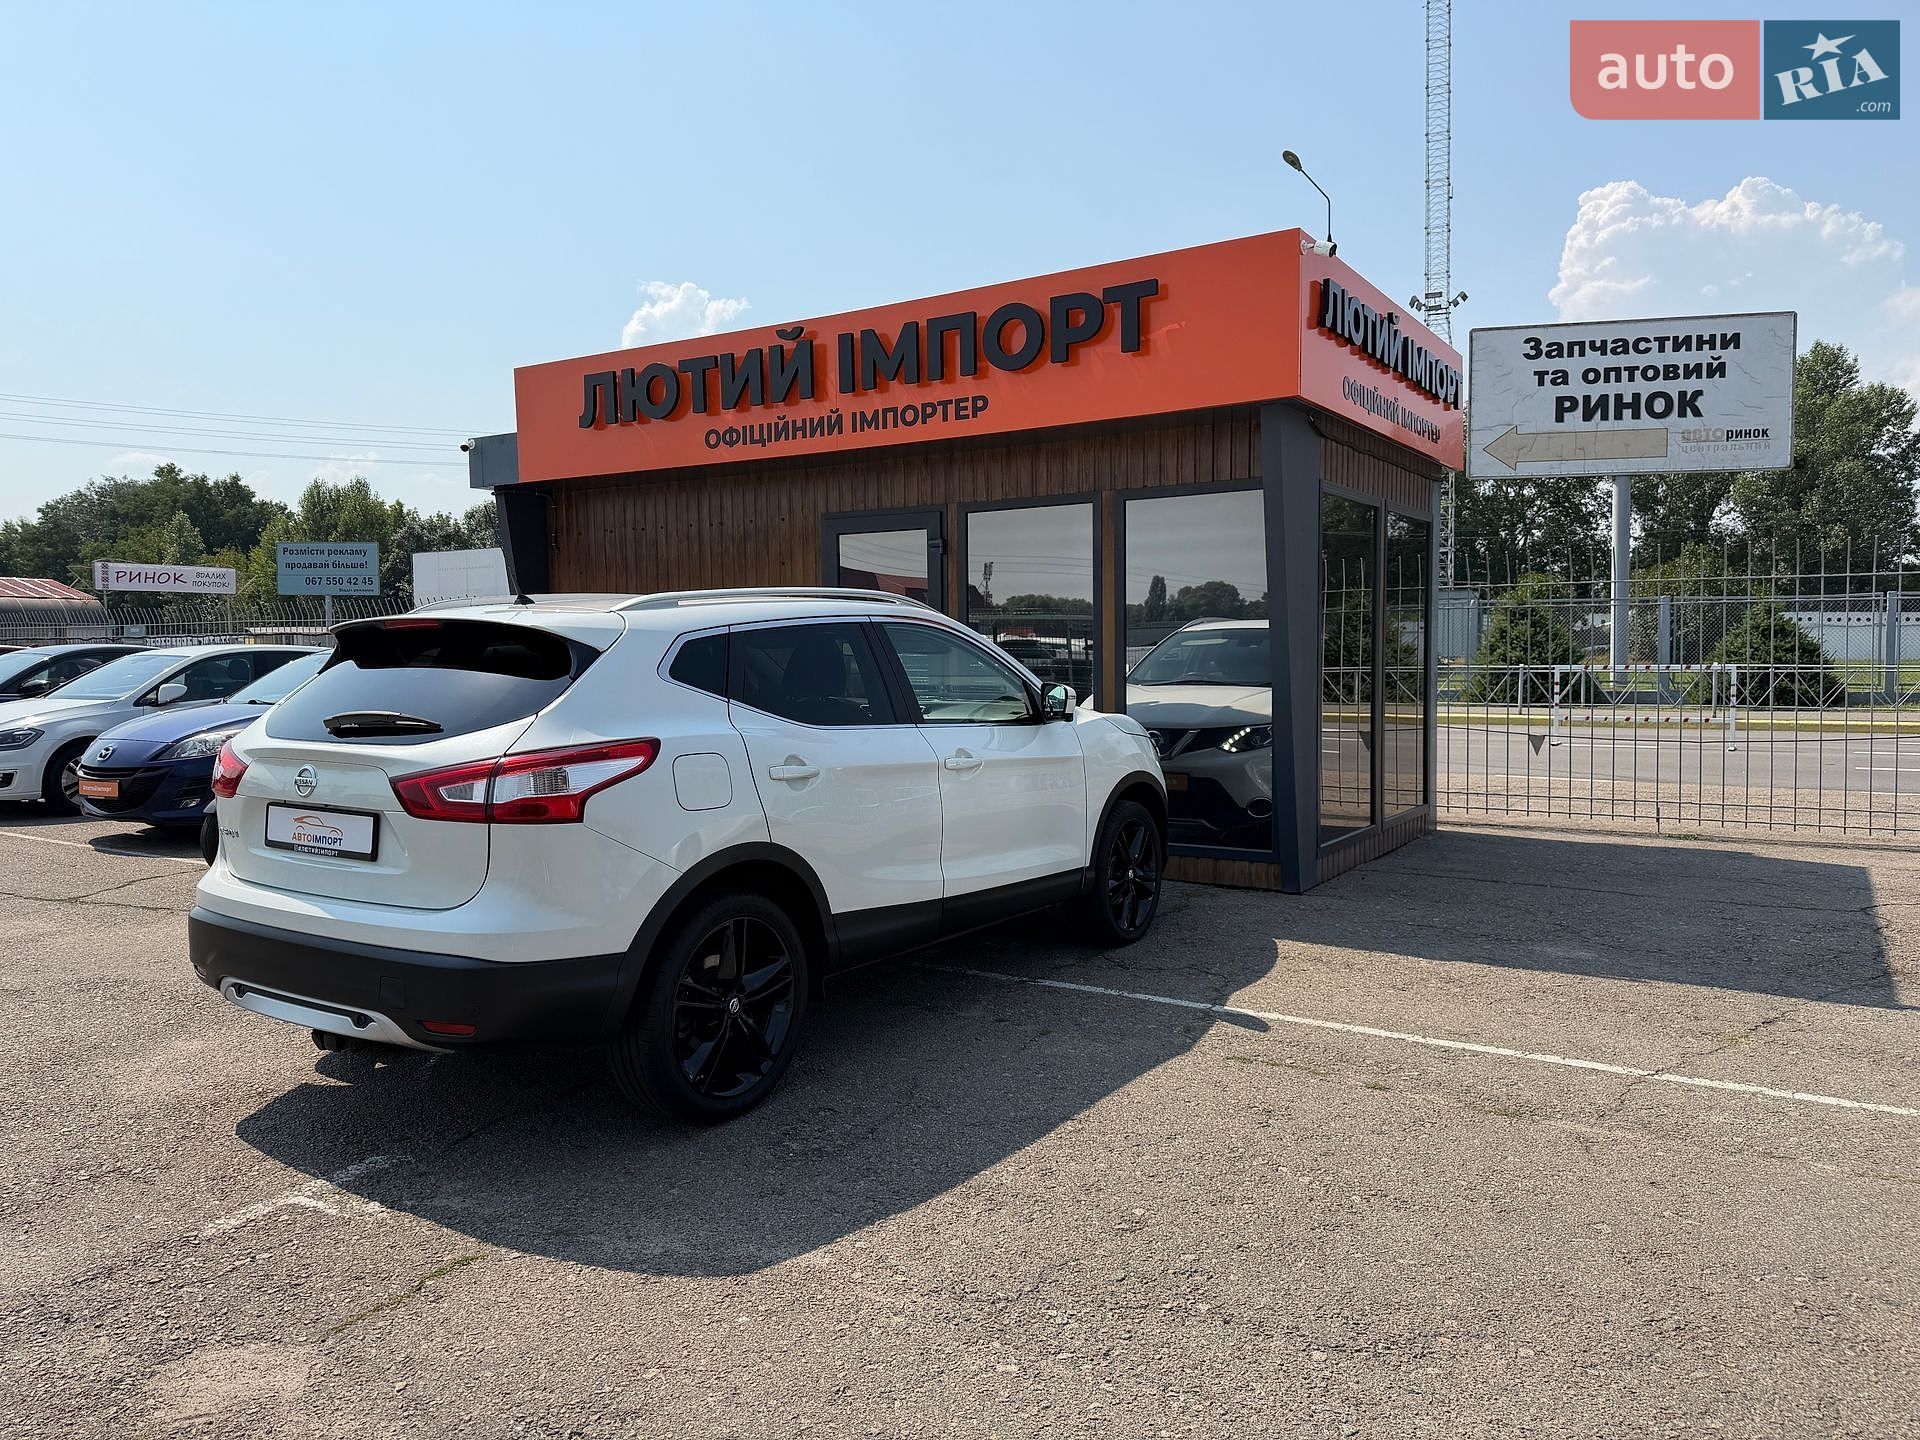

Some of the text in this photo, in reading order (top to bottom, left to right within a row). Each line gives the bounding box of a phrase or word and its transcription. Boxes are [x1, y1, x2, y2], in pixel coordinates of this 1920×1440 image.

[579, 278, 1158, 429] ЛЮТИЙ ІМПОРТ
[1320, 277, 1463, 411] ЛЮТИЙ ІМПОРТ
[1522, 332, 1741, 360] Запчастини
[1533, 355, 1727, 387] та оптовий
[1342, 375, 1441, 445] ОФІЦІЙНИЙ ІМПОРТЕР
[1554, 389, 1704, 423] РИНОК
[704, 394, 989, 451] ОФІЦІЙНИЙ ІМПОРТЕР
[1681, 441, 1771, 454] центральний
[282, 547, 368, 558] Розмісти рекламу
[285, 560, 368, 571] продавай більше!
[114, 570, 188, 585] РИНОК
[191, 580, 230, 589] ПОКУПОК!
[305, 576, 374, 586] 067 550 42 45
[291, 832, 343, 847] АВТОІМПОРТ
